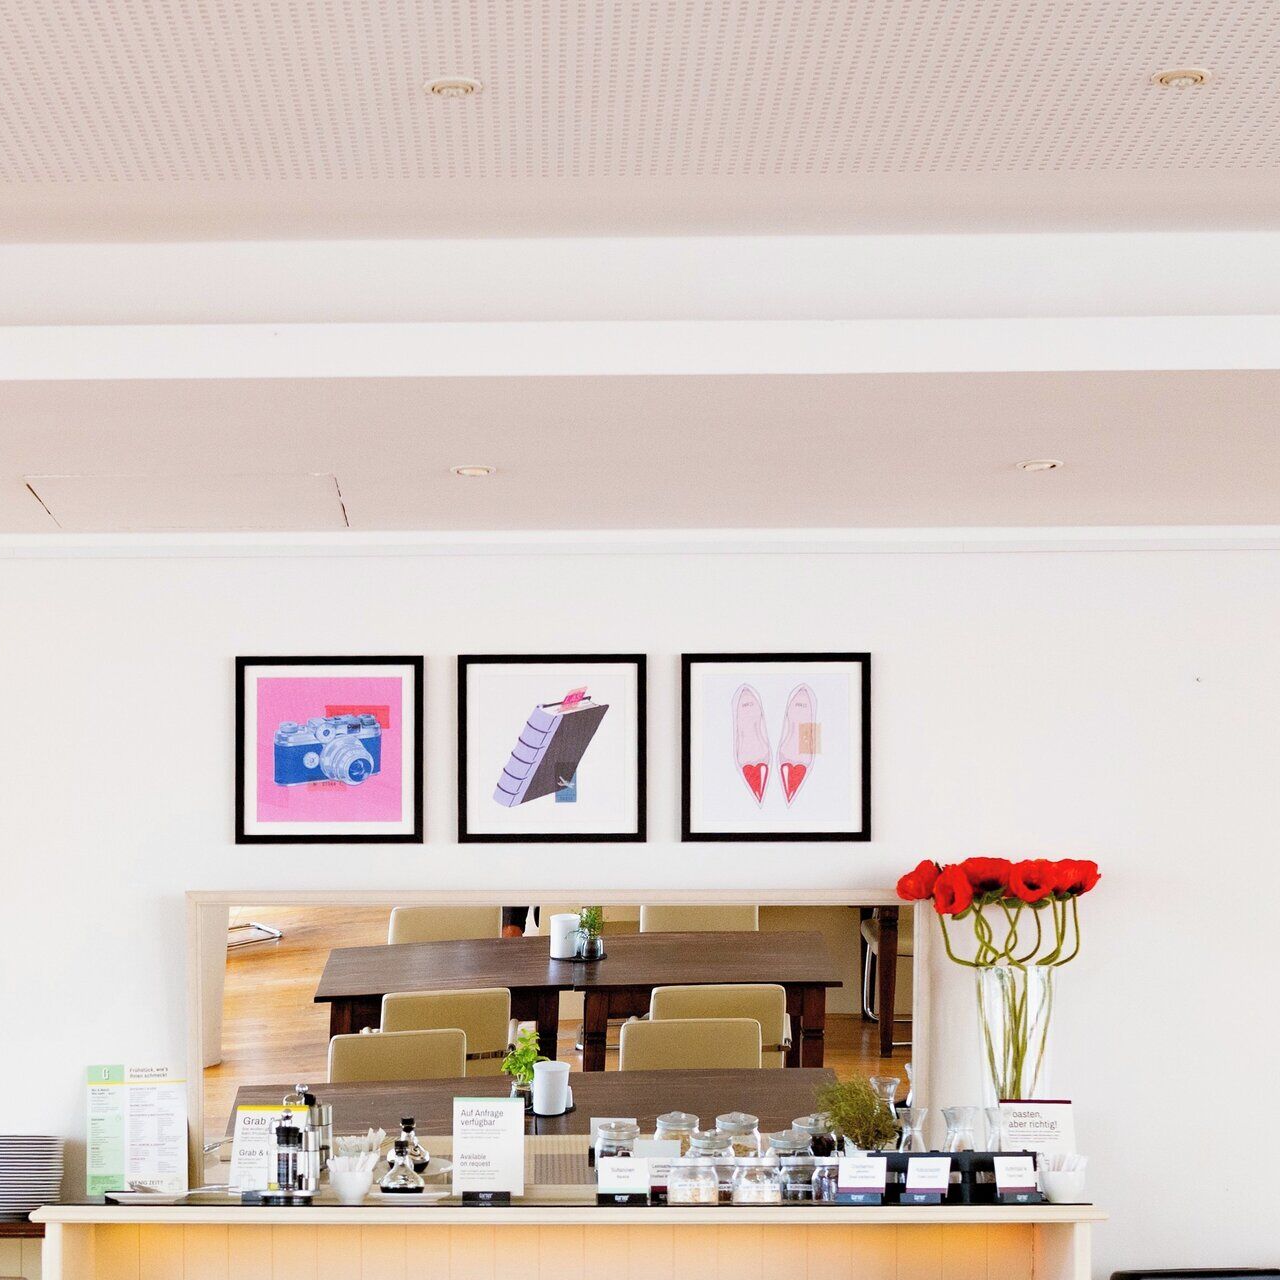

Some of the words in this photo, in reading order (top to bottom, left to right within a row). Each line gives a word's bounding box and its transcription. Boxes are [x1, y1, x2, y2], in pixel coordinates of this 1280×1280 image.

[461, 1109, 473, 1117] Auf
[475, 1109, 504, 1118] Anfrage
[1012, 1111, 1043, 1119] oasten,
[243, 1116, 266, 1125] Grab
[460, 1119, 495, 1128] verfügbar
[1029, 1121, 1057, 1130] richtig!
